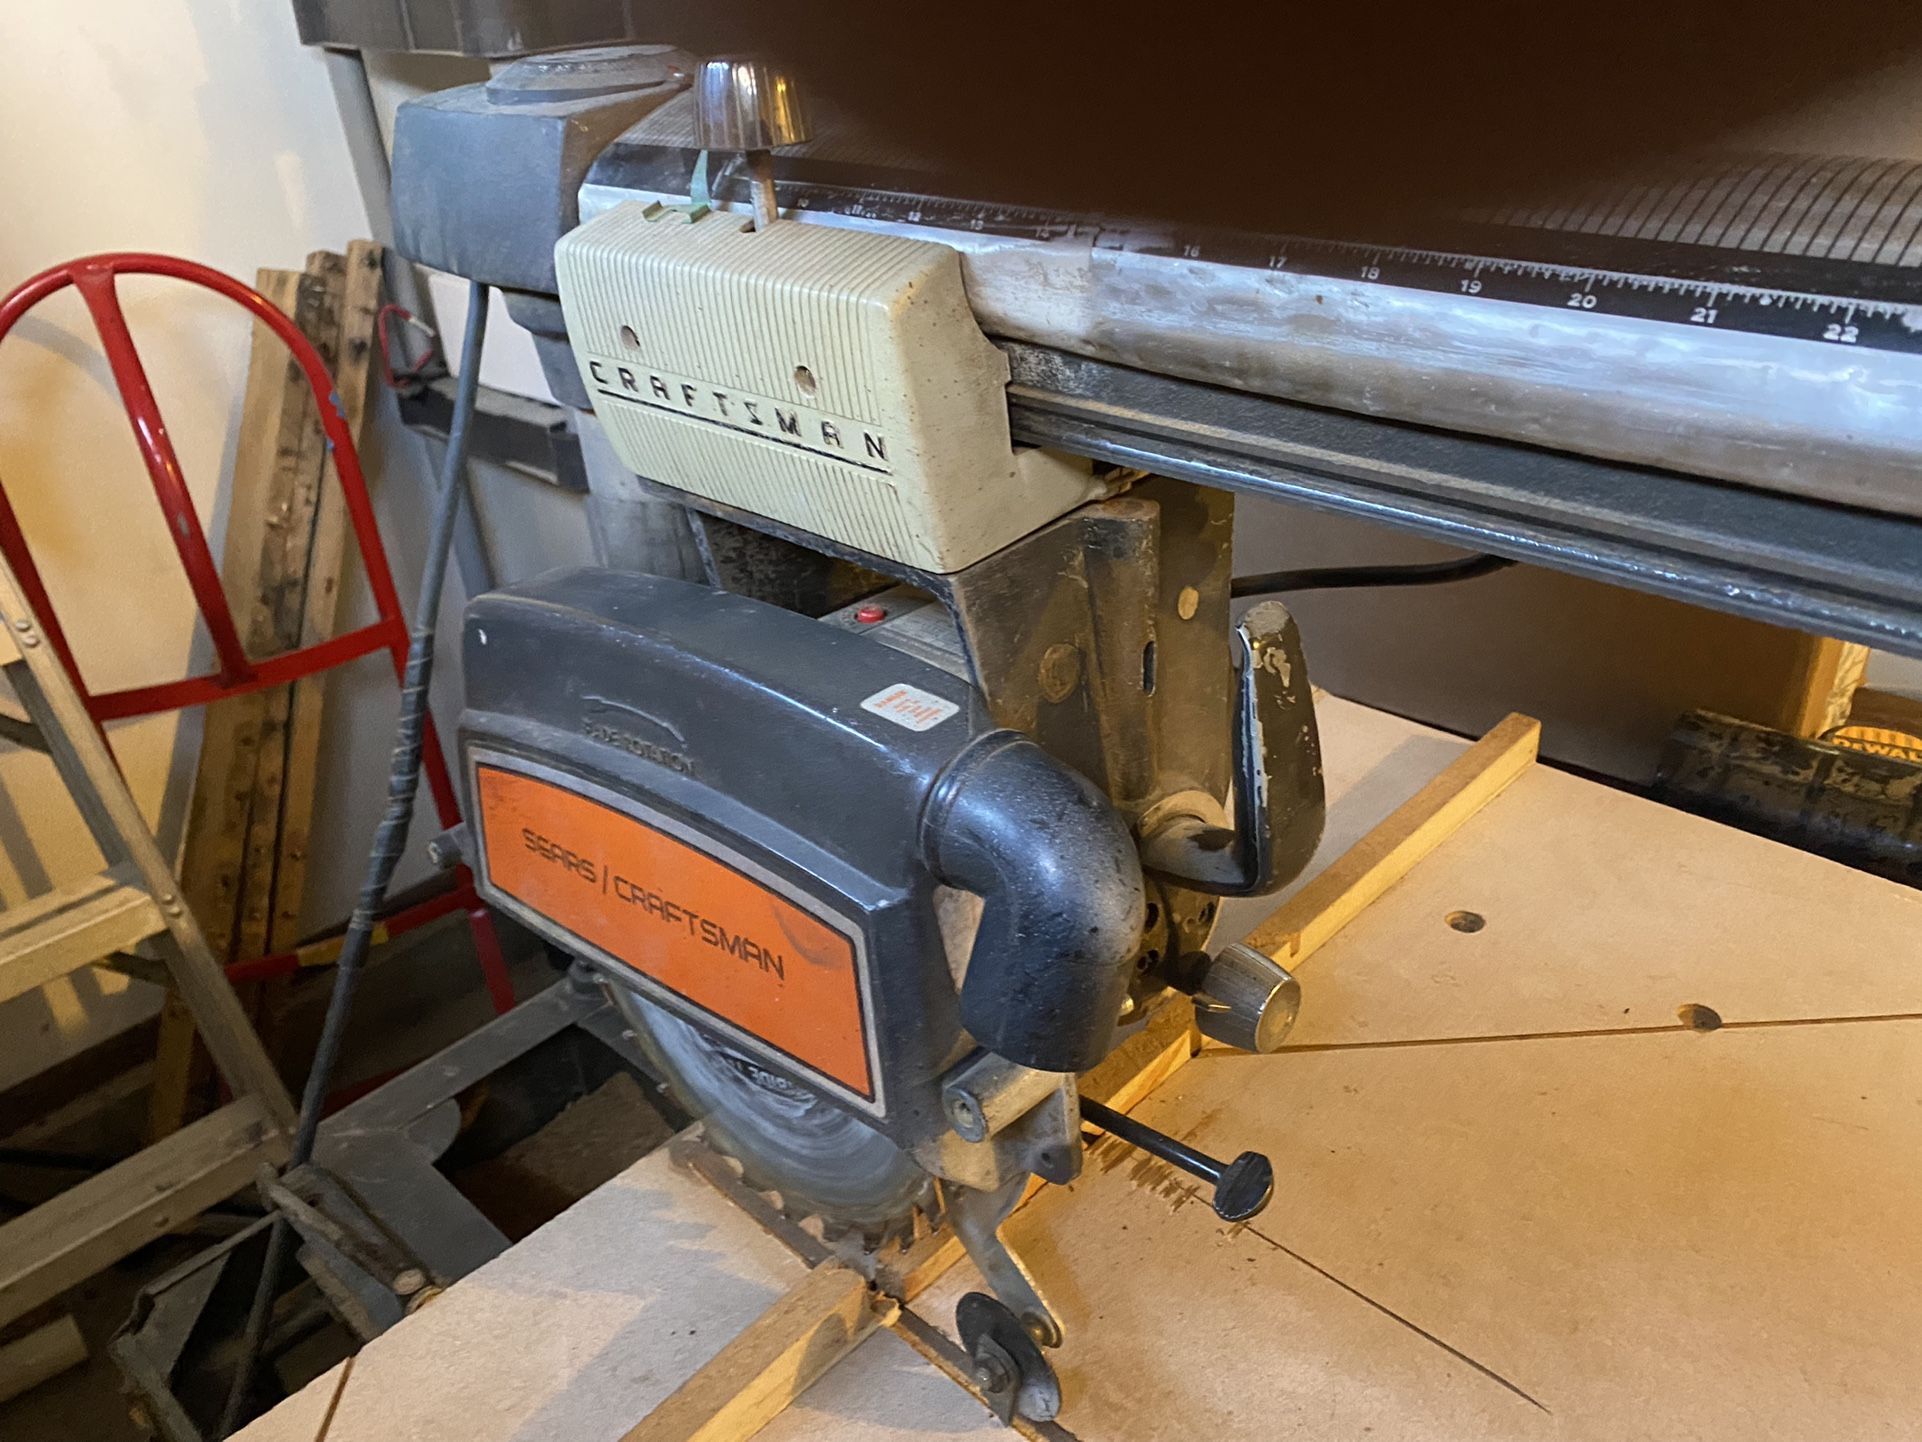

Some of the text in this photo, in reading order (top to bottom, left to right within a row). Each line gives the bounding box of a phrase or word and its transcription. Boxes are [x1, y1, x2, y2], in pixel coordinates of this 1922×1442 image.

[1183, 244, 1201, 258] 16
[1269, 255, 1289, 269] 17
[1360, 265, 1381, 280] 18
[1459, 279, 1483, 295] 19
[1567, 292, 1598, 309] 20
[1690, 306, 1719, 325] 21
[1822, 323, 1860, 344] 22
[588, 360, 890, 462] CRAFTSMAN
[1831, 737, 1922, 762] DEWAL
